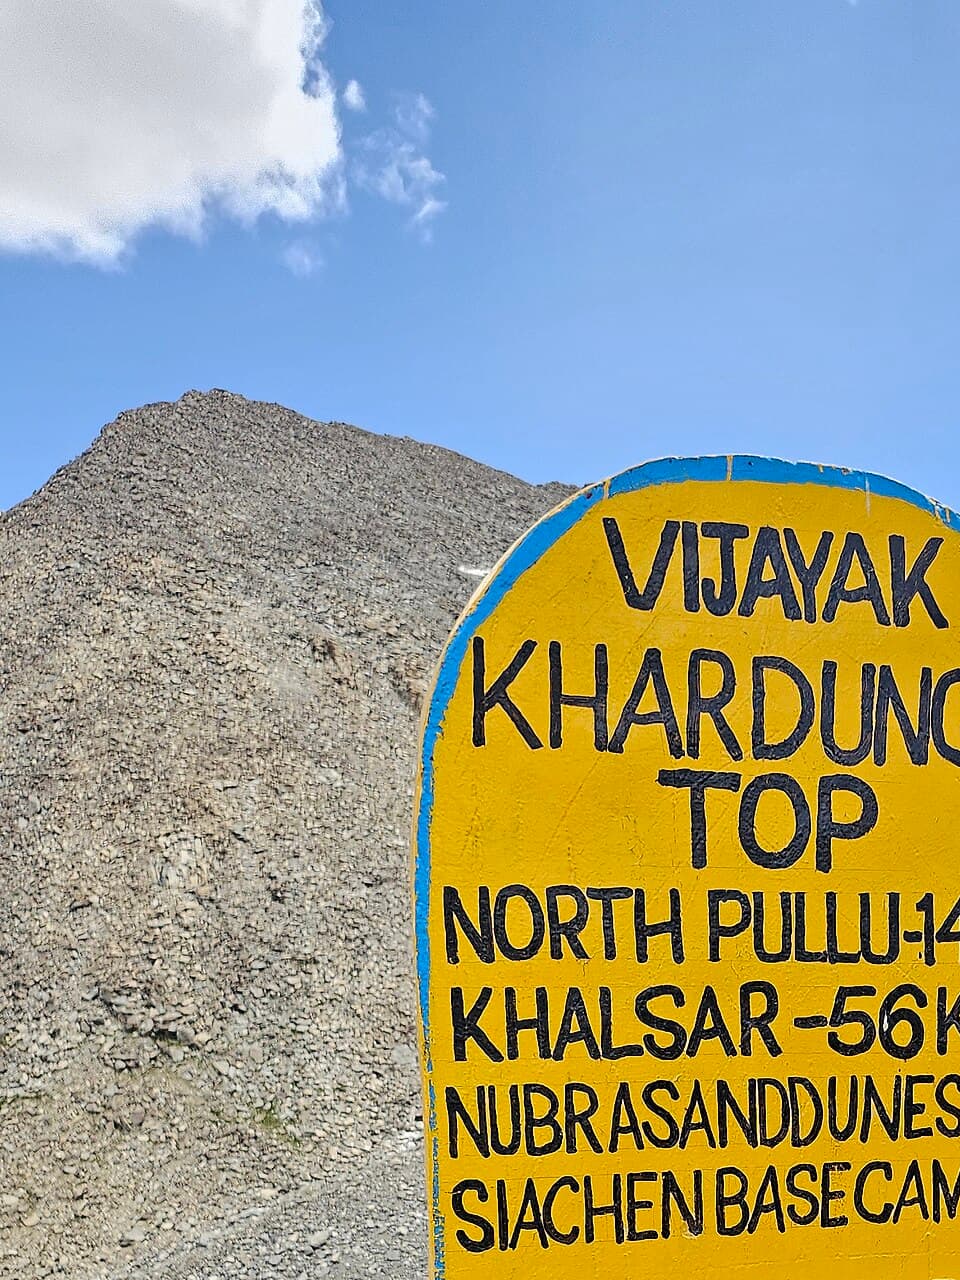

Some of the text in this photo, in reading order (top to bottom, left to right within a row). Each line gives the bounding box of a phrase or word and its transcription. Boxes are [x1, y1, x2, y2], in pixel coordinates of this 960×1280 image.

[603, 518, 949, 630] VIJAYAK
[655, 769, 879, 873] TOP
[443, 884, 685, 965] NORTH
[451, 981, 783, 1062] KHALSAR
[451, 1170, 704, 1253] SIACHEN
